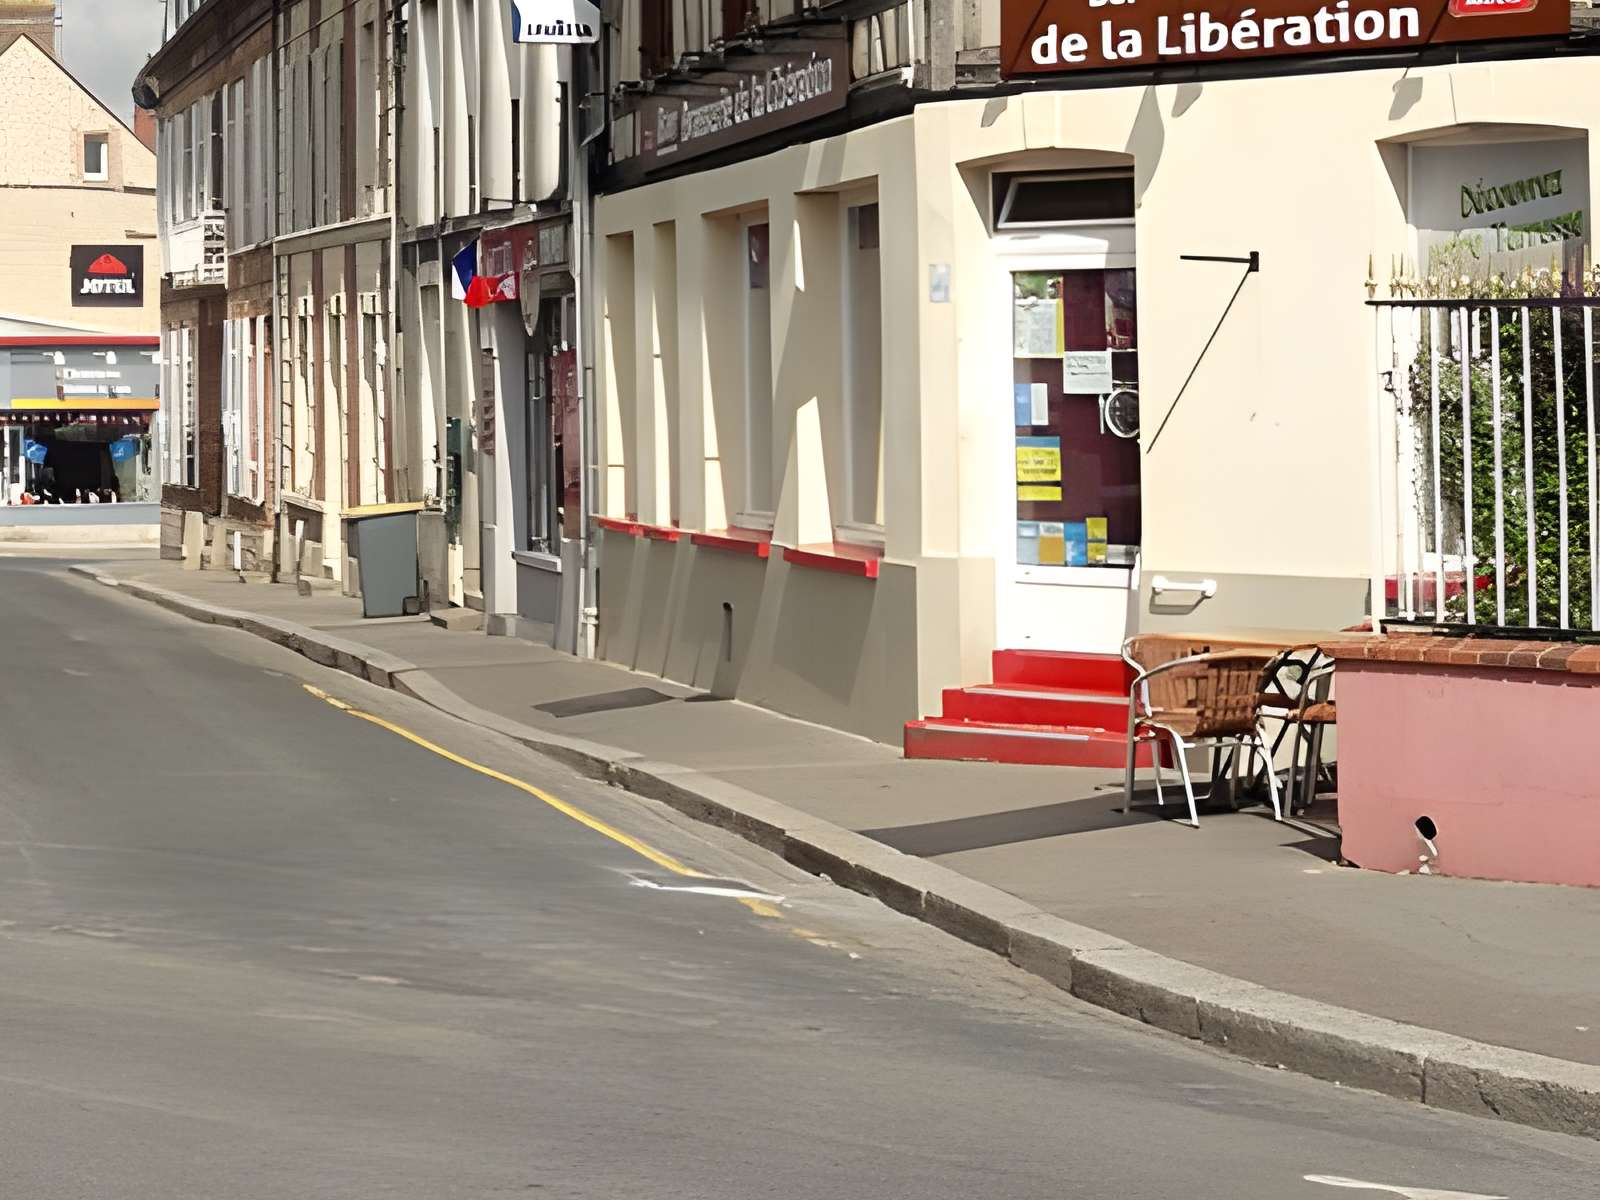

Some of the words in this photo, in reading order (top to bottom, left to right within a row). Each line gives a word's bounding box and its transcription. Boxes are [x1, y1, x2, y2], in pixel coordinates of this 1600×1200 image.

[1031, 23, 1088, 65] de
[1101, 20, 1143, 60] la
[1157, 0, 1420, 56] Libération
